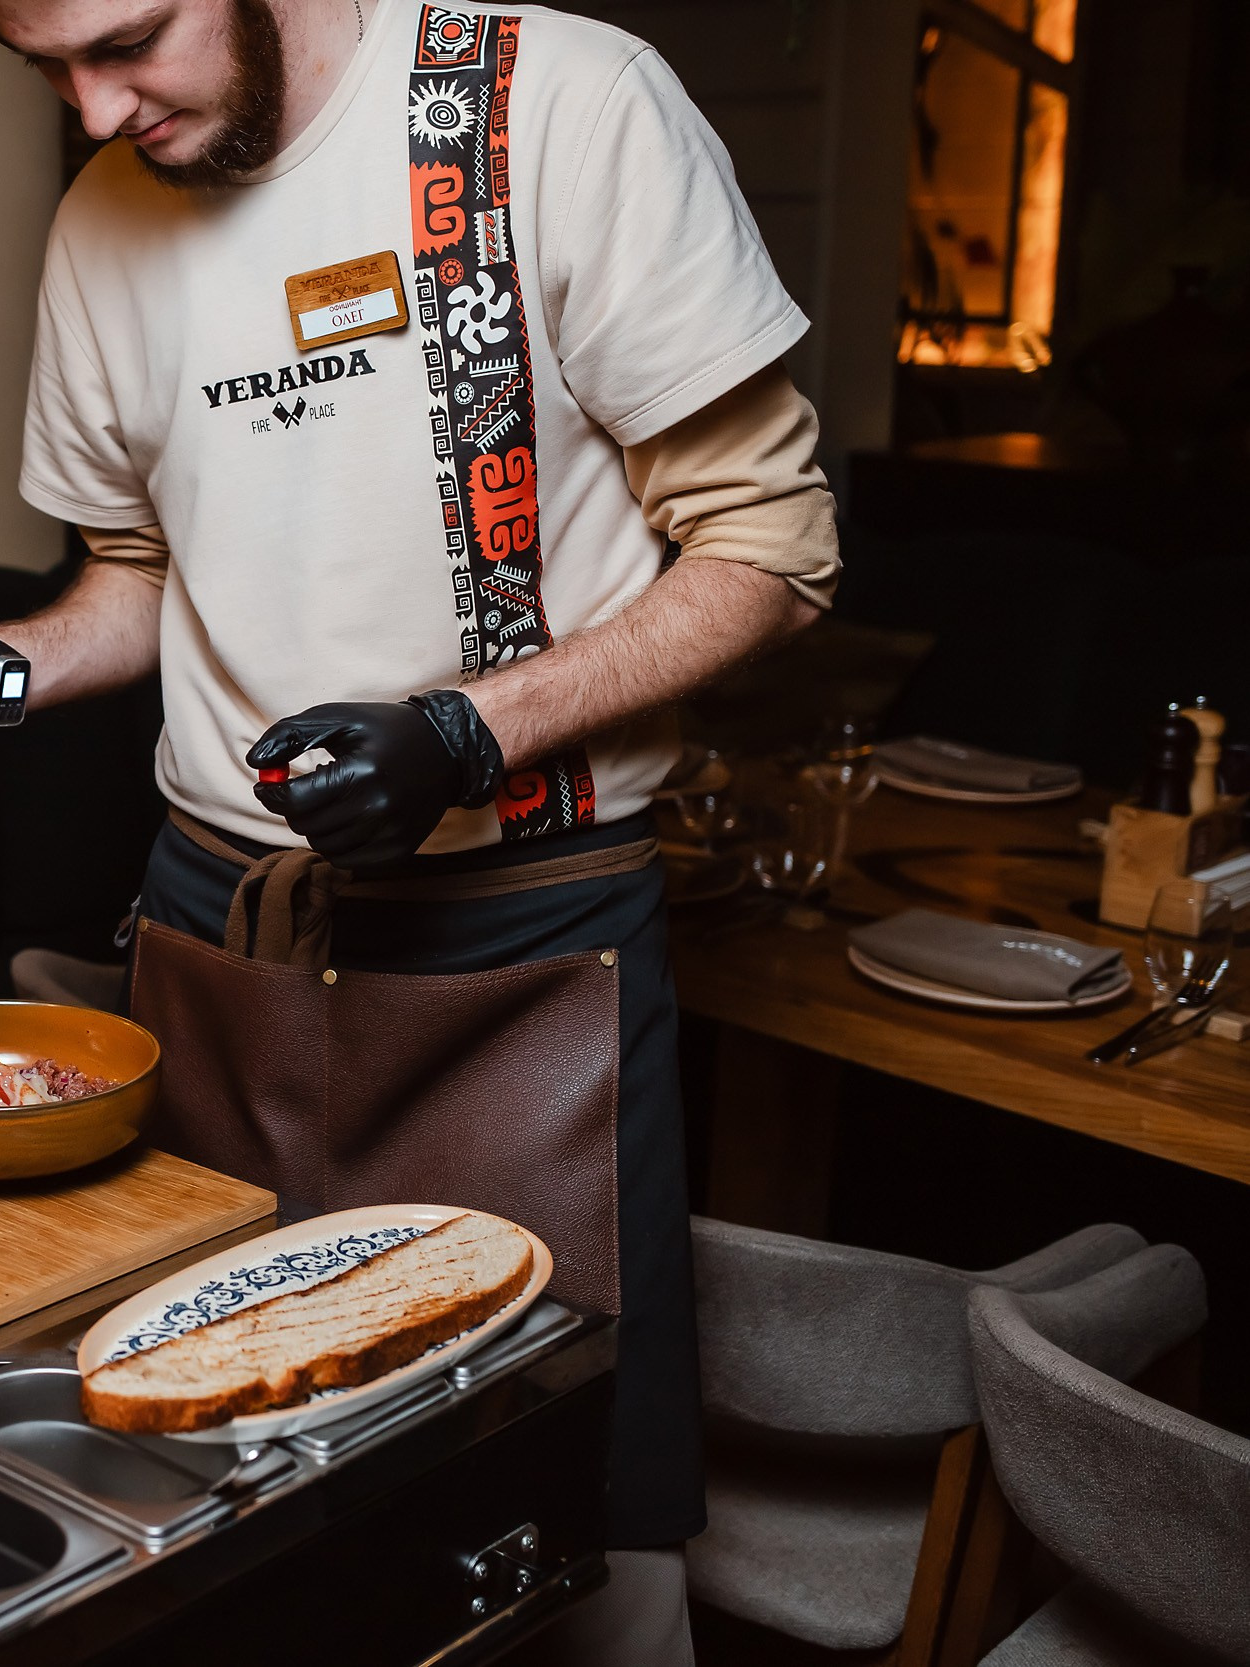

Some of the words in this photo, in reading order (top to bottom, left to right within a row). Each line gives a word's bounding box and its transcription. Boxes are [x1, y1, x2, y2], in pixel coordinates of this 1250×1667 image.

[299, 262, 382, 292] VERANDA
[352, 284, 371, 295] PLACE
[329, 299, 362, 312] ОФИЦИАНТ
[332, 309, 365, 327] ОЛЕГ
[201, 349, 376, 409] VERANDA
[251, 418, 271, 434] FIRE
[309, 402, 336, 421] PLACE
